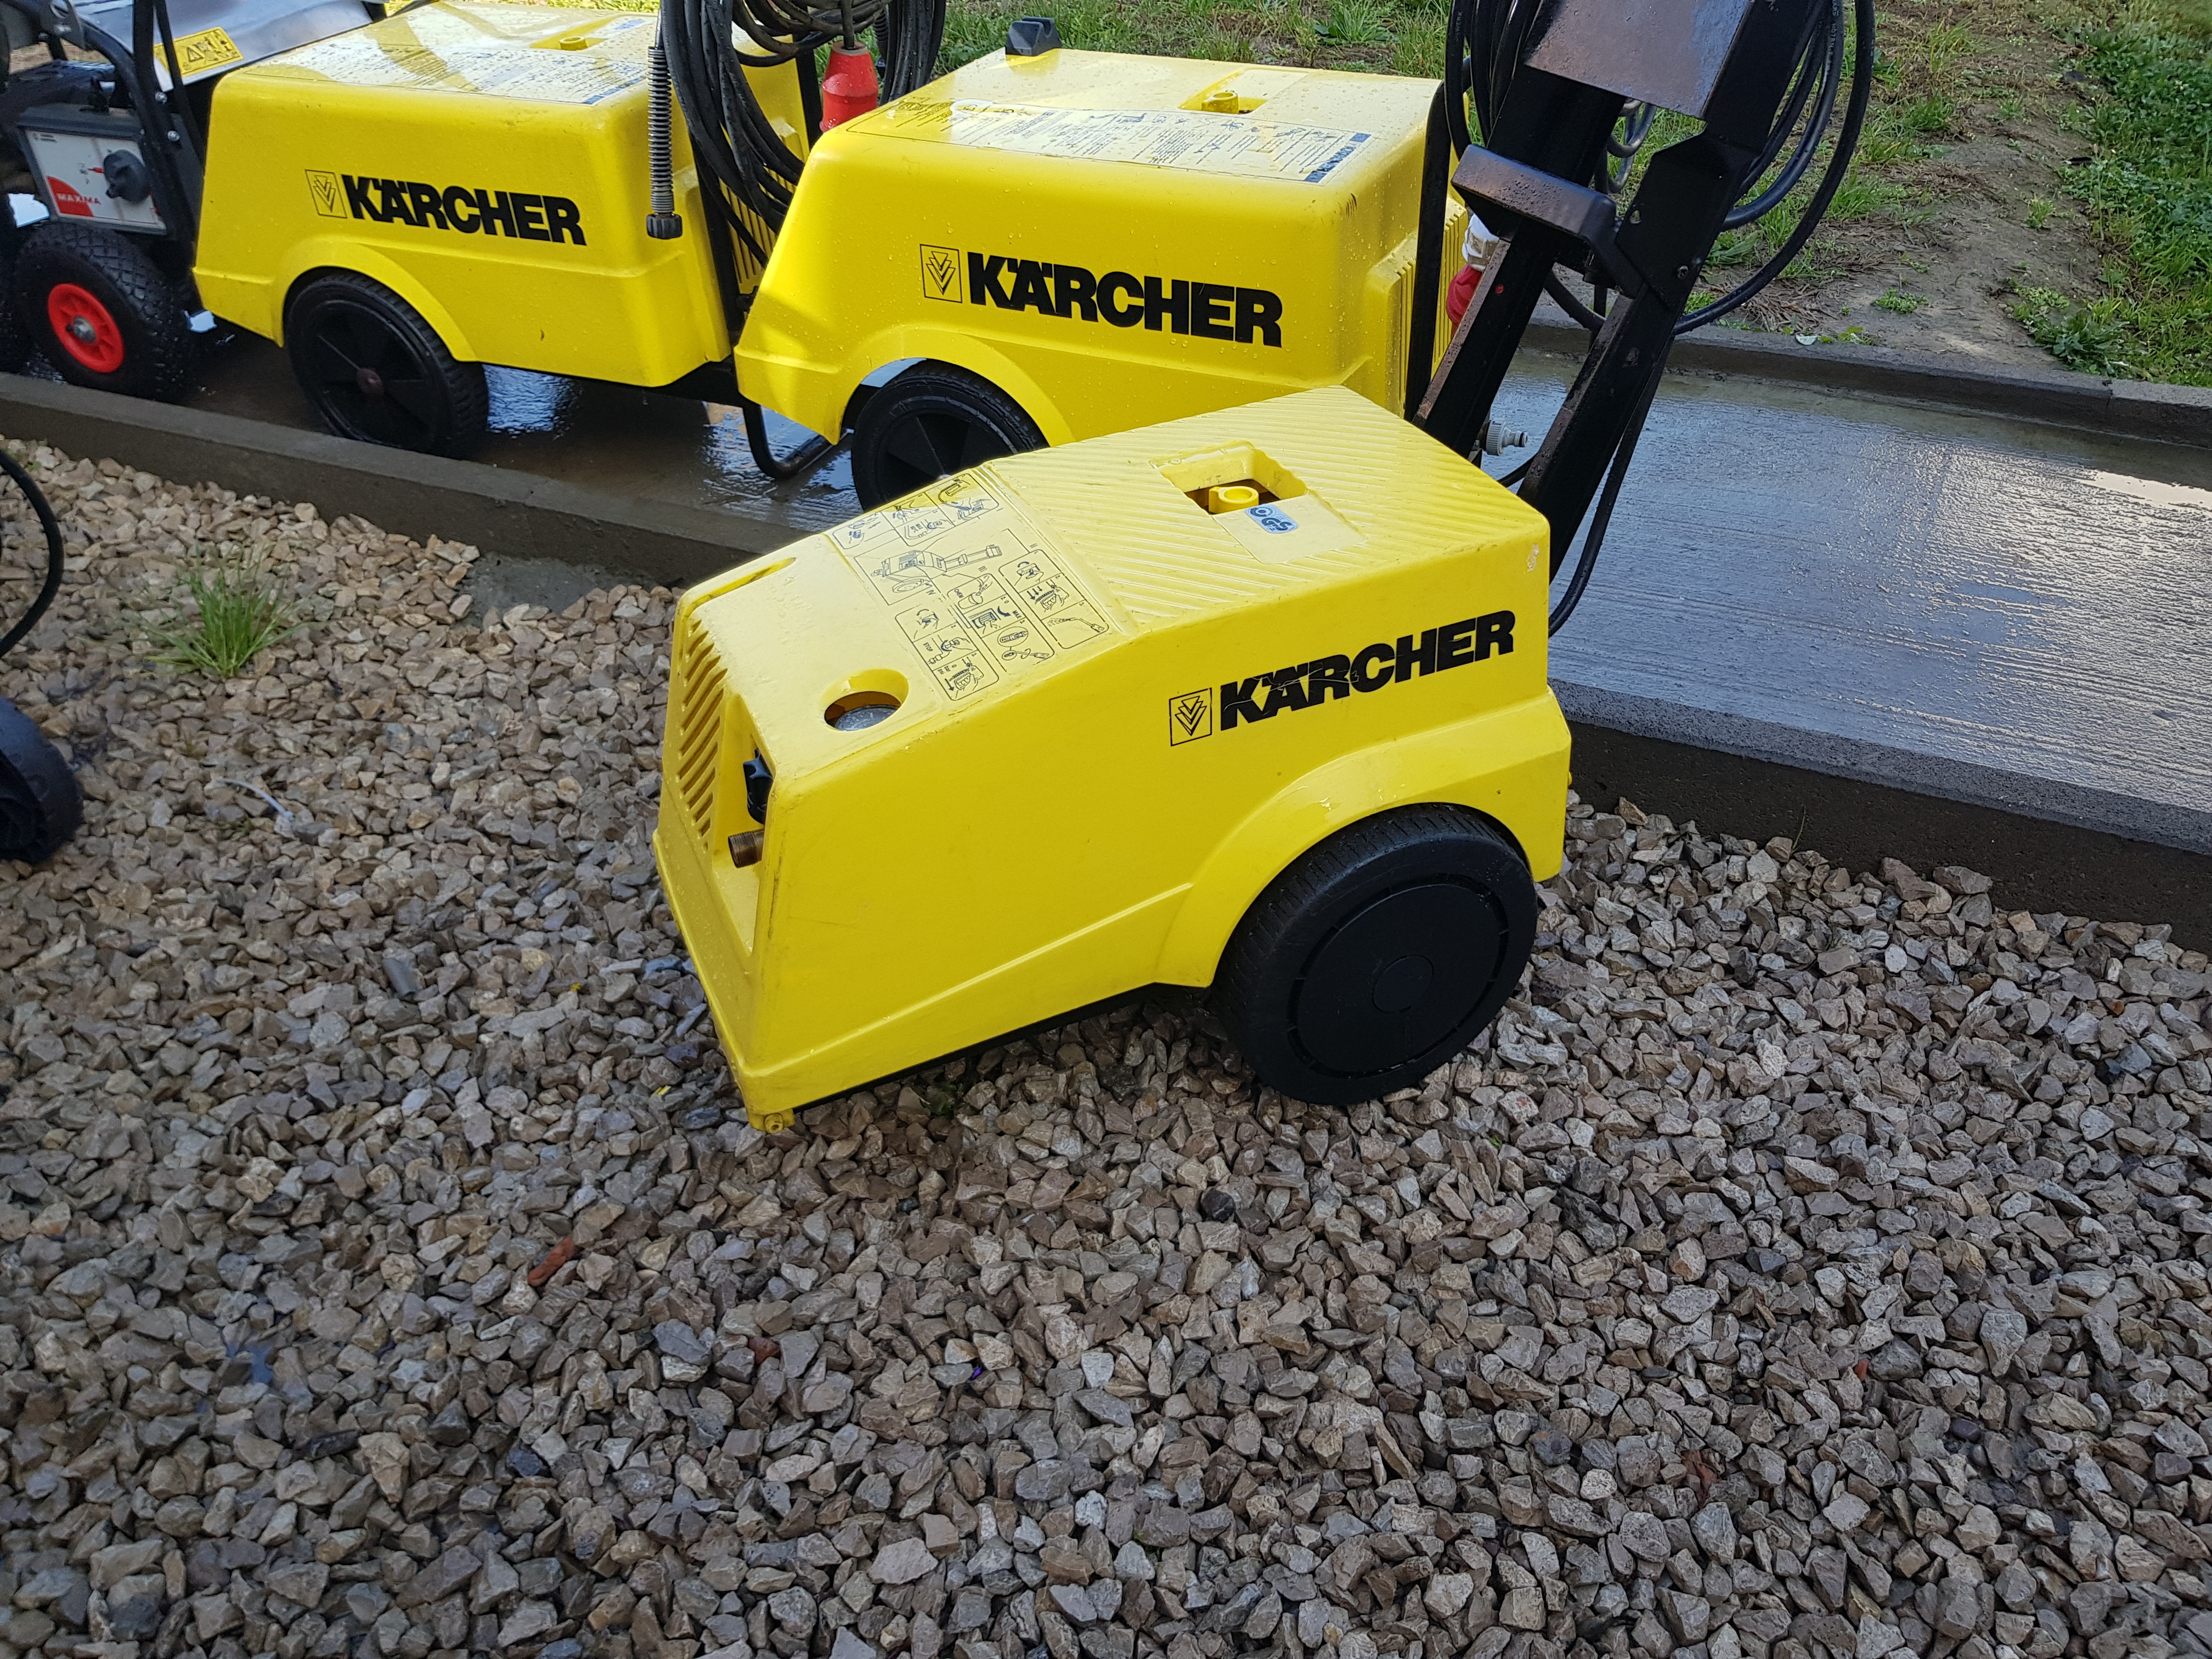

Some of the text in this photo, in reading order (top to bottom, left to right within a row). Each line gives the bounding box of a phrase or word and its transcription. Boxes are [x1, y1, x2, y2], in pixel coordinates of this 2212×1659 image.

[57, 193, 101, 204] MAXIMA
[341, 174, 586, 246] KÄRCHER
[968, 252, 1282, 347] KÄRCHER
[1012, 610, 1022, 618] MAX
[923, 642, 933, 652] STOP
[1221, 611, 1515, 731] KÄRCHER
